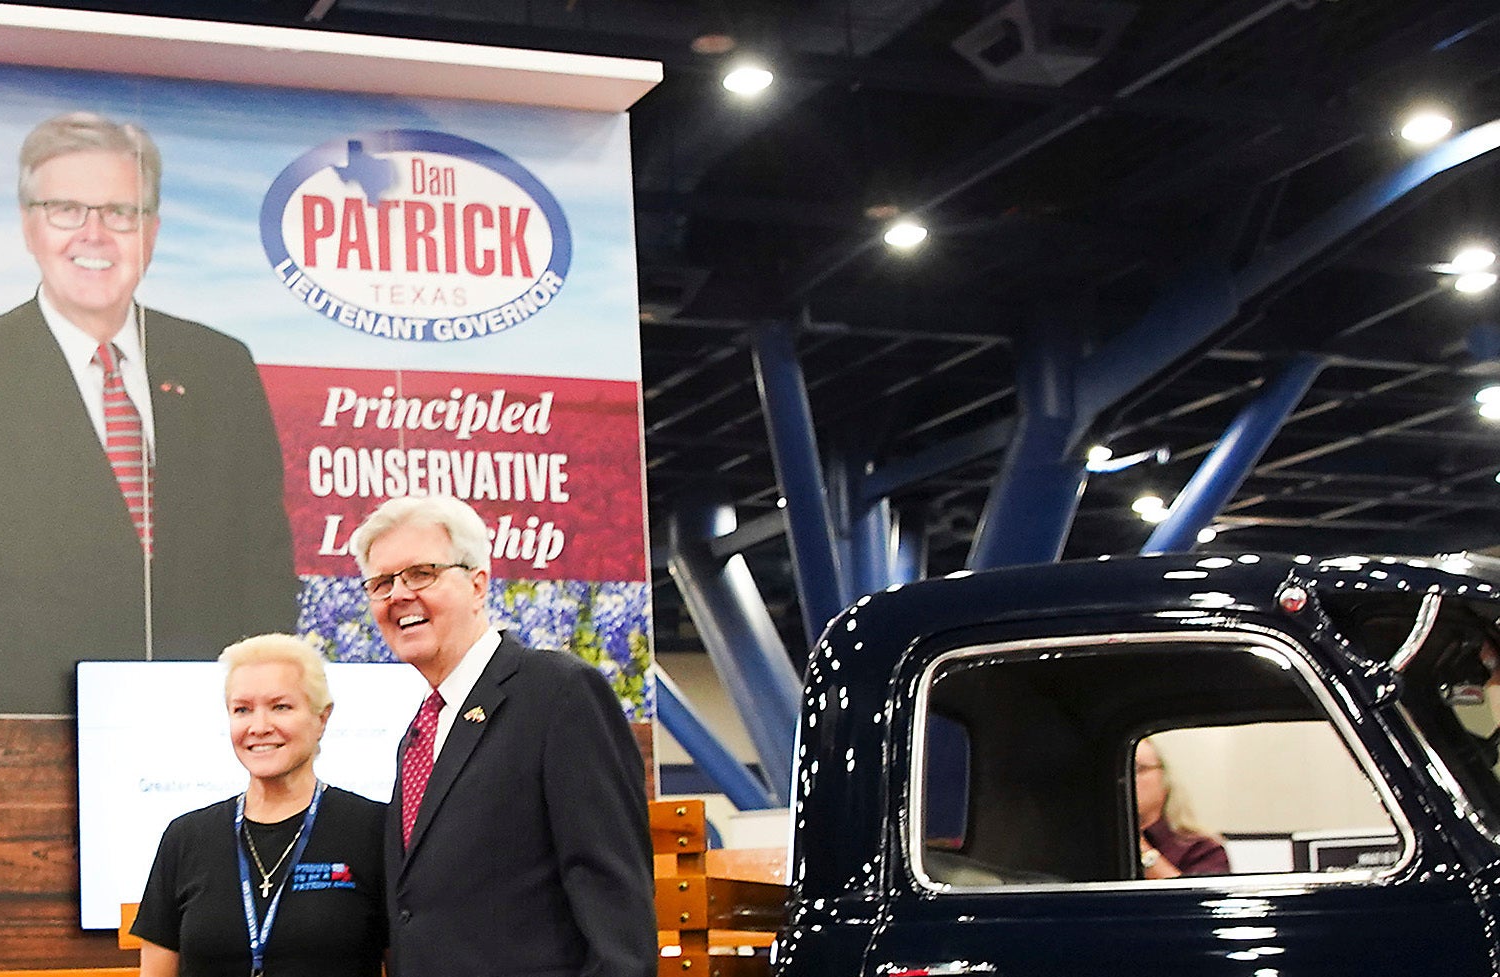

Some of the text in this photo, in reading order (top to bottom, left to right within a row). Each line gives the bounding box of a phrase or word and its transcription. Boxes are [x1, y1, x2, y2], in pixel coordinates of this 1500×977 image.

[411, 158, 456, 196] Dan
[301, 194, 534, 279] PATRICK
[274, 258, 564, 342] LIEUTENANT GOVERNOR
[369, 283, 468, 307] TEXAS
[320, 386, 555, 440] Principled
[308, 446, 570, 503] CONSERVATIVE
